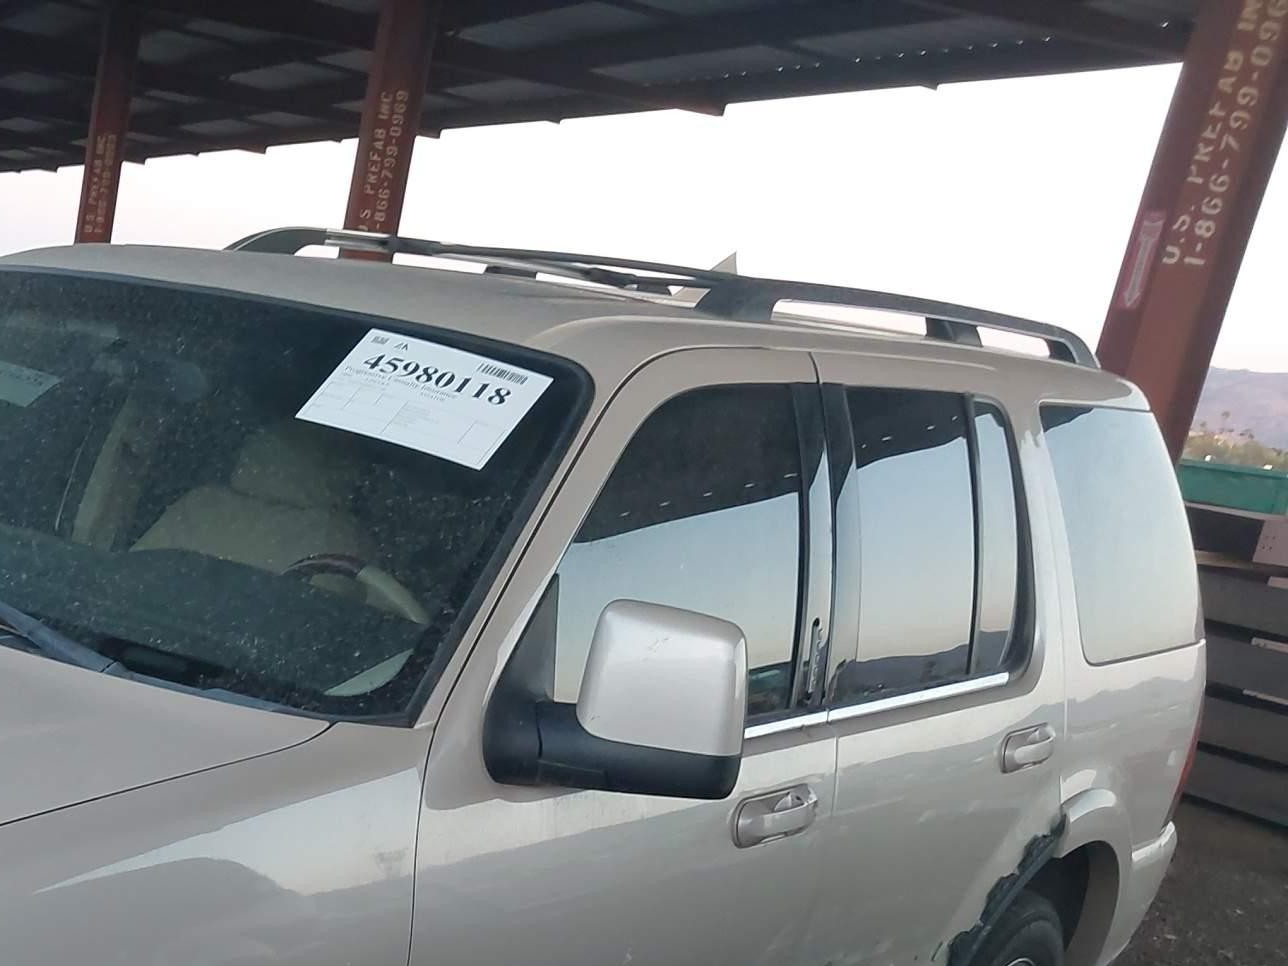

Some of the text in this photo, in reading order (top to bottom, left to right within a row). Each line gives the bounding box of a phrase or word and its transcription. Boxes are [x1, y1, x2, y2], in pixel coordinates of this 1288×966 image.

[364, 128, 387, 195] PREFAB
[374, 90, 409, 230] -866-799-0969
[363, 354, 512, 406] 45980118
